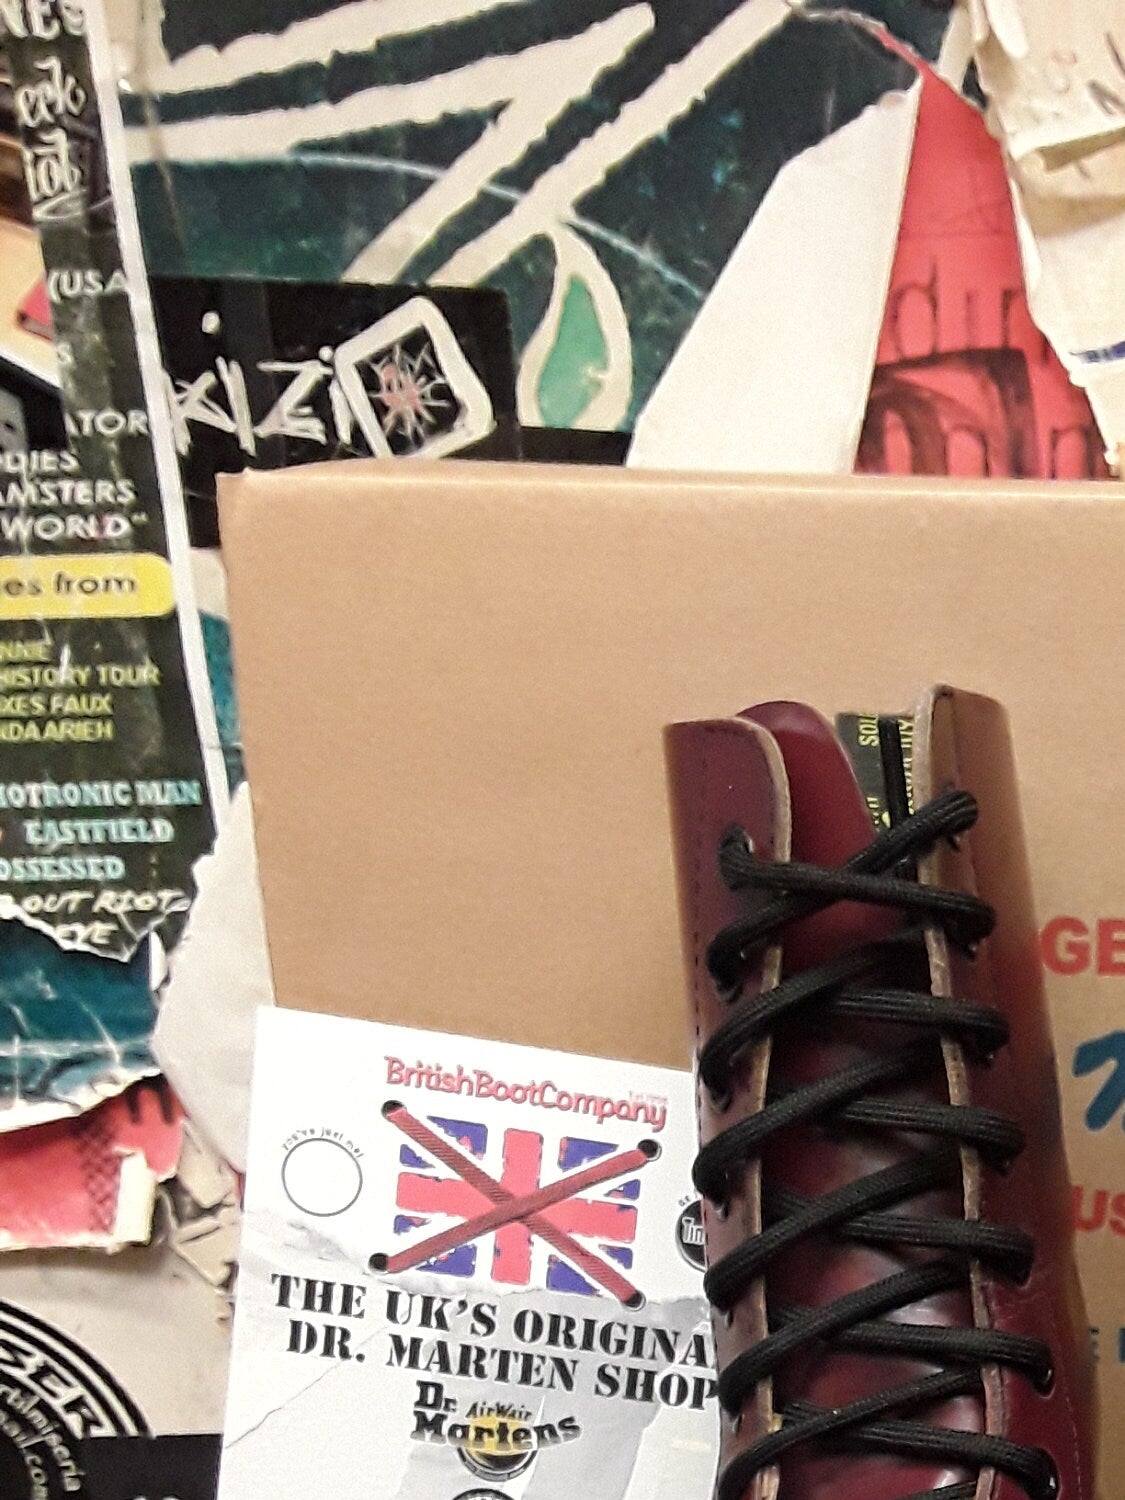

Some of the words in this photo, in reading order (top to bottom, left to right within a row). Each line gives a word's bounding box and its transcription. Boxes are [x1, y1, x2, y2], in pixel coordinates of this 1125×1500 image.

[55, 568, 137, 597] from
[134, 780, 202, 806] MAN
[271, 1273, 367, 1319] THE
[385, 1288, 497, 1337] UK'S
[513, 1308, 714, 1369] ORIGINA
[285, 1318, 366, 1364] DR.
[386, 1333, 581, 1392] MARTEN
[593, 1363, 718, 1411] SHOP
[410, 1410, 581, 1450] Martens
